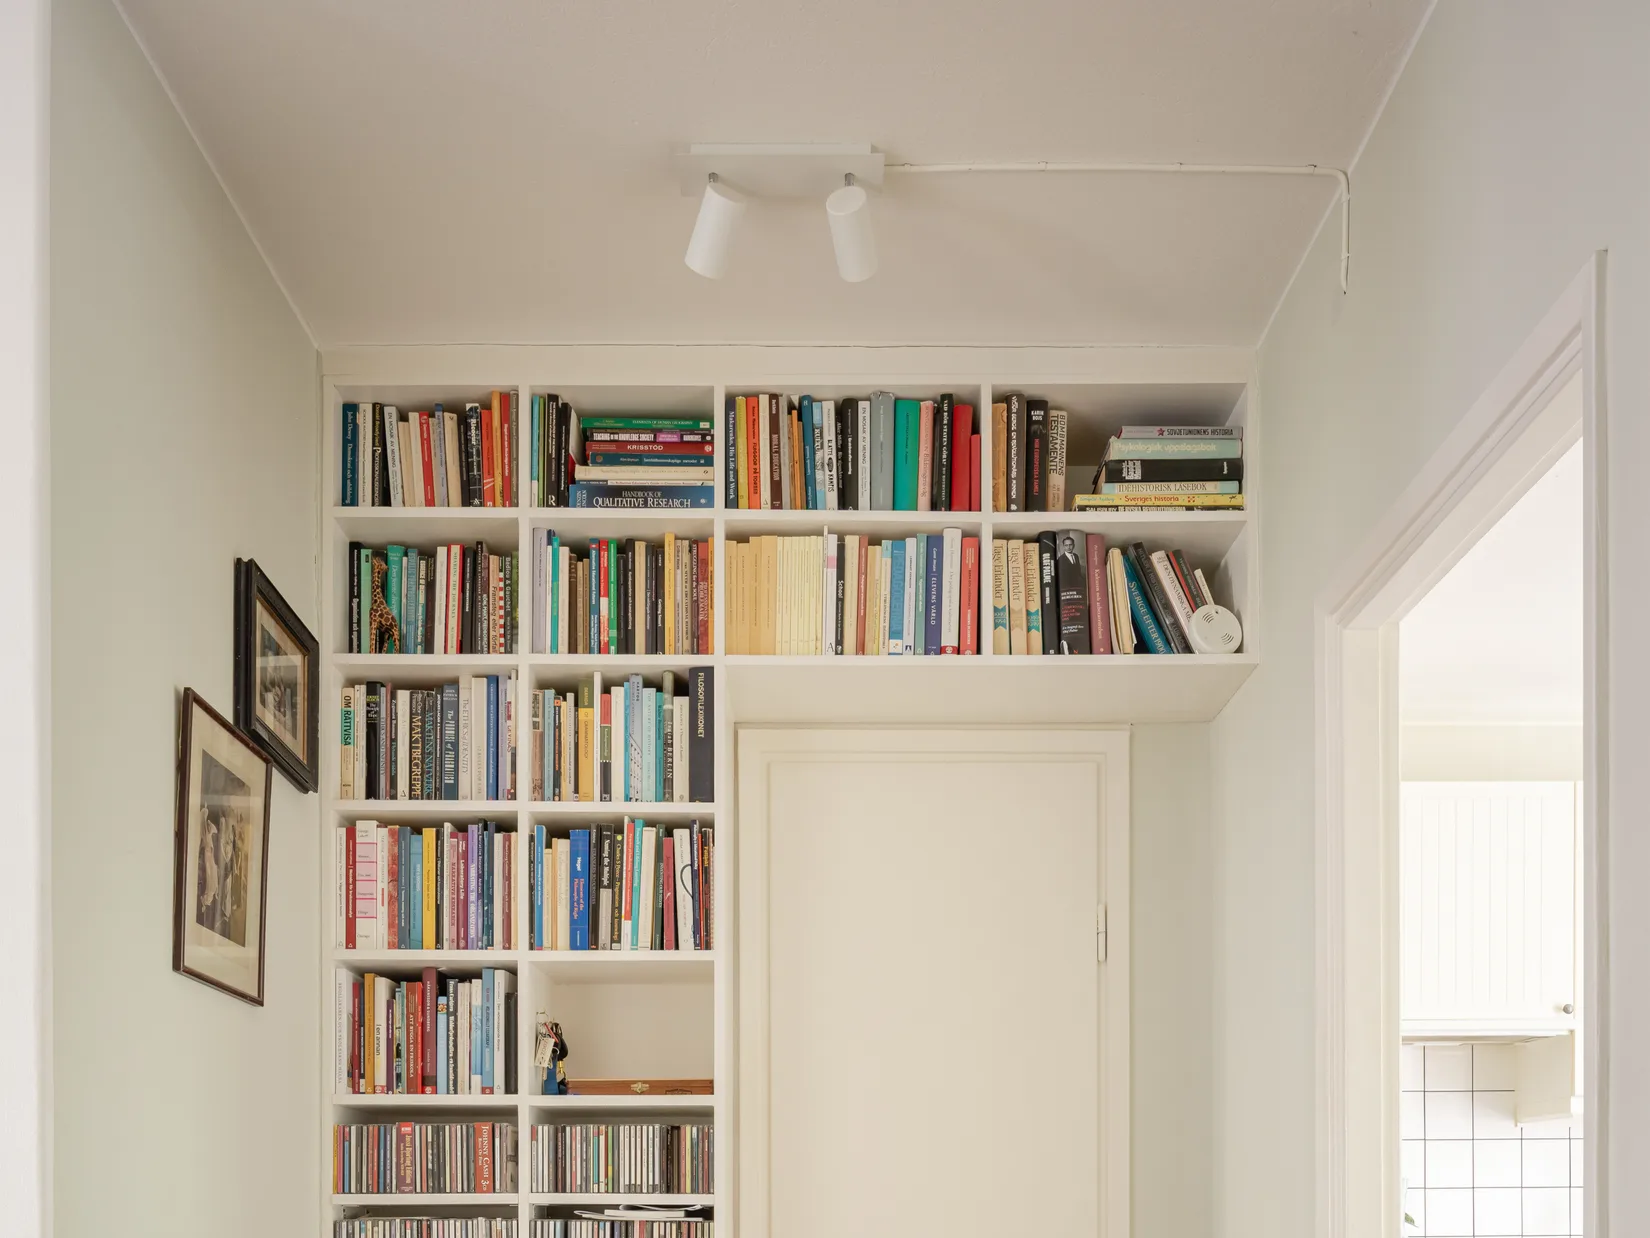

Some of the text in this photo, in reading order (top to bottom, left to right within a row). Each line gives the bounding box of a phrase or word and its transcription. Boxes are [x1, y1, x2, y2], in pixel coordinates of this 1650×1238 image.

[1049, 414, 1059, 475] TESTAMENTE
[1058, 415, 1066, 476] BOMBMANNENS
[1115, 443, 1217, 454] Psykologisk uppslagsbok
[593, 498, 691, 508] QUALITATIVE RESEARCH
[1118, 483, 1172, 493] IDÉHISTORISK
[993, 544, 1004, 599] Tage Erlander
[1008, 545, 1022, 601] Tage Erlander
[1024, 547, 1037, 603] Tage Erlander
[1128, 582, 1166, 654] SVERIGE EFTER 1900
[343, 695, 352, 746] OM RÄTTVISA
[425, 712, 433, 752] MAKTENS
[411, 715, 421, 798] MAKTBEGREPPE
[445, 751, 455, 783] PRAGMATISM
[481, 1126, 489, 1155] JOHNNY
